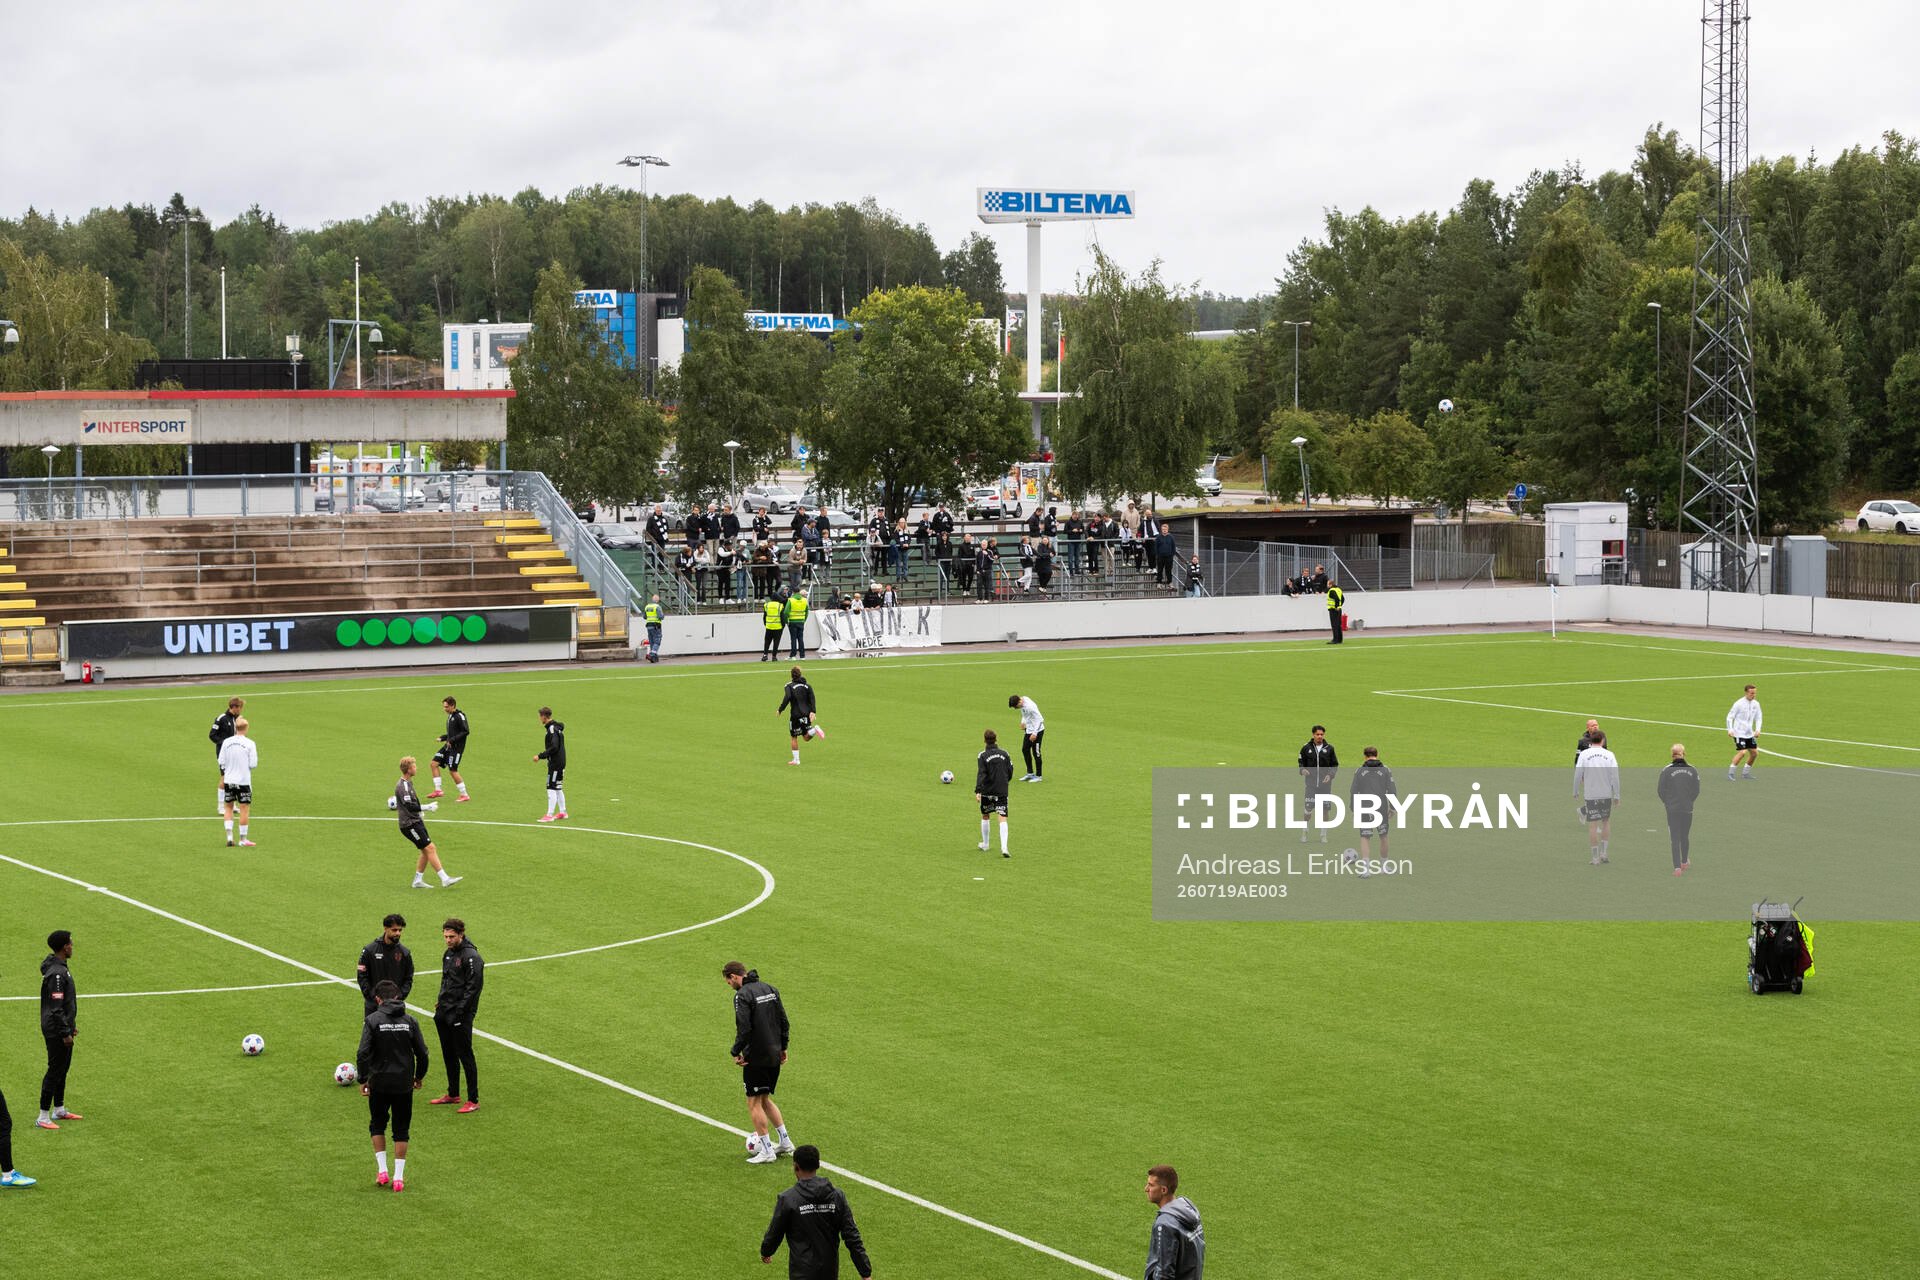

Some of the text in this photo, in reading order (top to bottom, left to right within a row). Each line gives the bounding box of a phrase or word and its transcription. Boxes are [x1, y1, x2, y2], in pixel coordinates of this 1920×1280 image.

[1001, 191, 1132, 215] BILTEMA
[575, 292, 614, 305] EMA
[754, 315, 831, 329] BILTEMA
[97, 420, 186, 433] INTERSPORT
[163, 621, 296, 654] UNIBET
